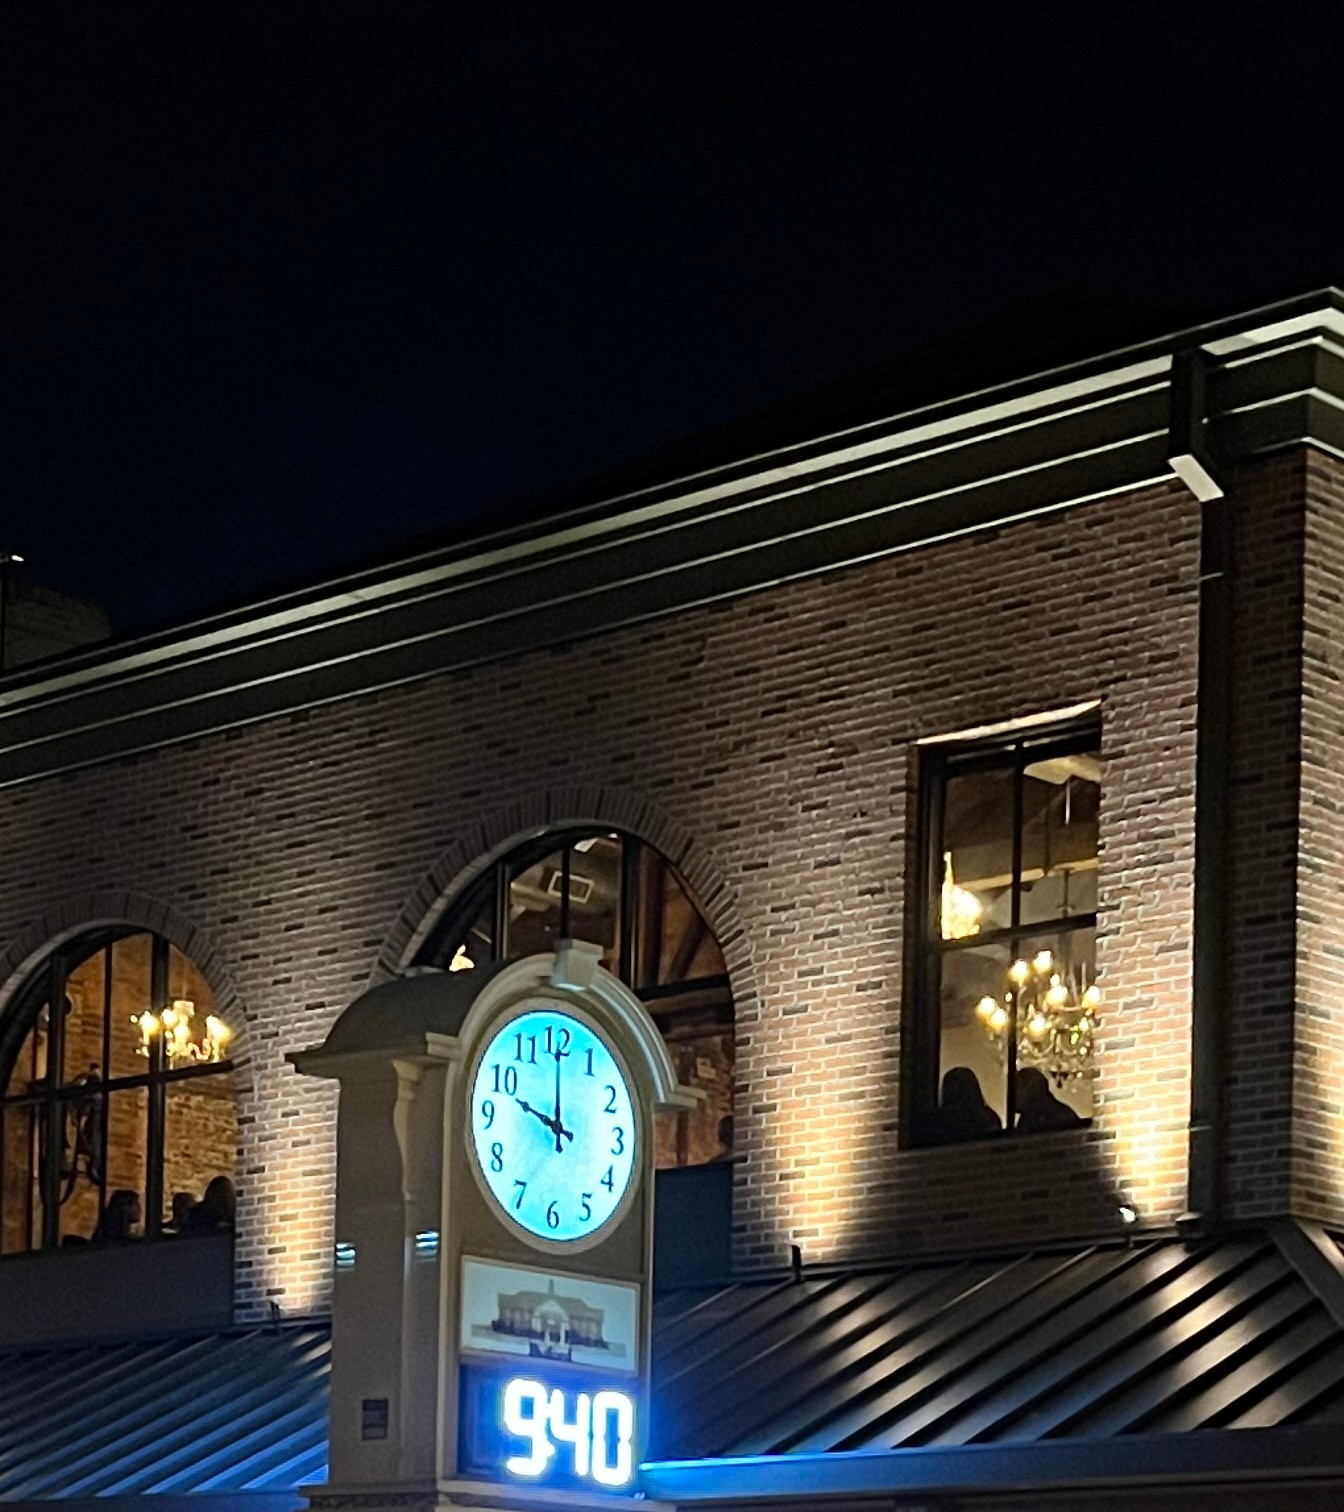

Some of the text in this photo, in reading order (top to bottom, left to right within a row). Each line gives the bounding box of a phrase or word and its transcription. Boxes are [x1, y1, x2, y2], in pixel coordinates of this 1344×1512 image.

[514, 1032, 538, 1065] 11
[543, 1025, 571, 1057] 12
[584, 1047, 596, 1078] 1
[490, 1063, 518, 1097] 10
[603, 1084, 617, 1114] 2
[481, 1100, 495, 1131] 9
[611, 1126, 624, 1156] 3
[490, 1142, 504, 1173] 8
[600, 1164, 615, 1193] 4
[513, 1179, 527, 1210] 7
[579, 1192, 593, 1222] 5
[546, 1200, 560, 1230] 6
